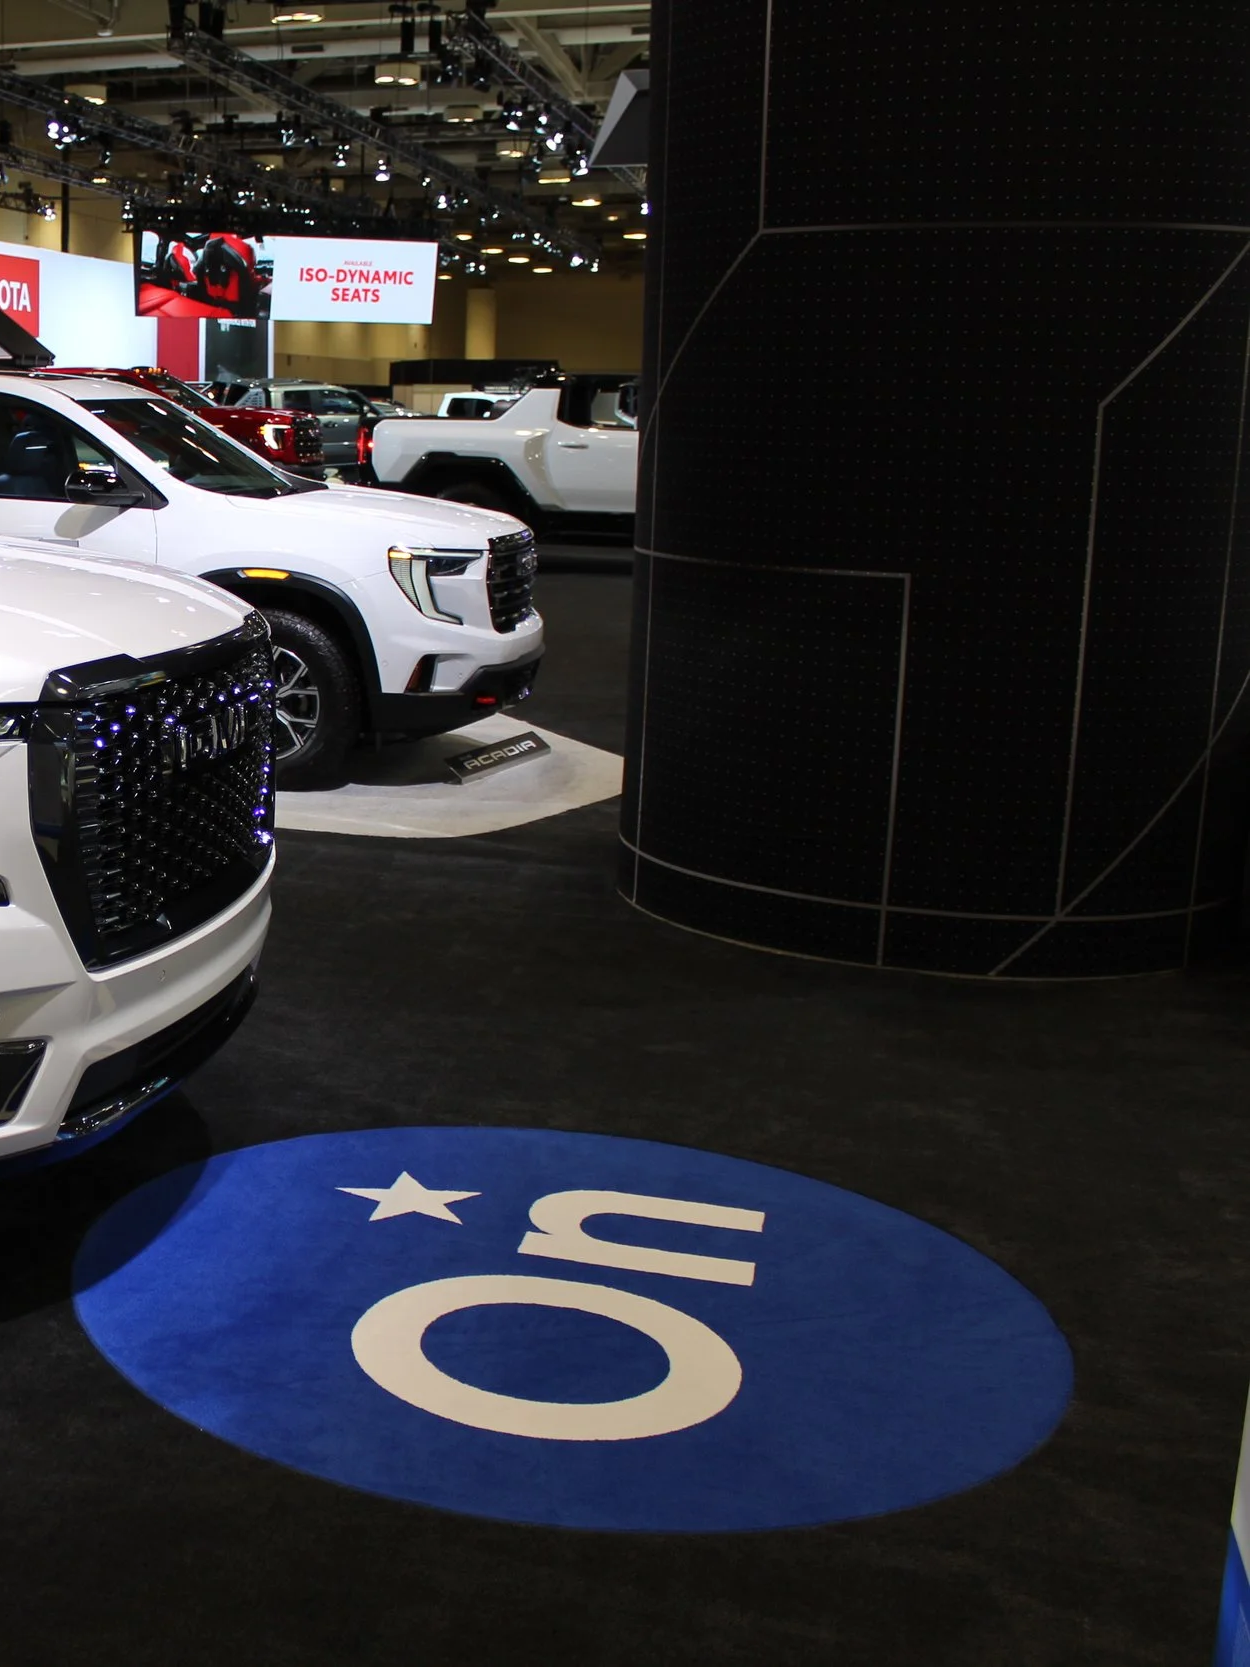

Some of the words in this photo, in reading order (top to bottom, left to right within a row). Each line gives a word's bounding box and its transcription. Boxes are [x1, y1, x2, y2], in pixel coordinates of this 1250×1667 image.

[299, 267, 414, 285] ISO-DYNAMIC
[331, 287, 381, 303] SEATS
[463, 739, 537, 770] ACADIA
[351, 1189, 766, 1441] On
